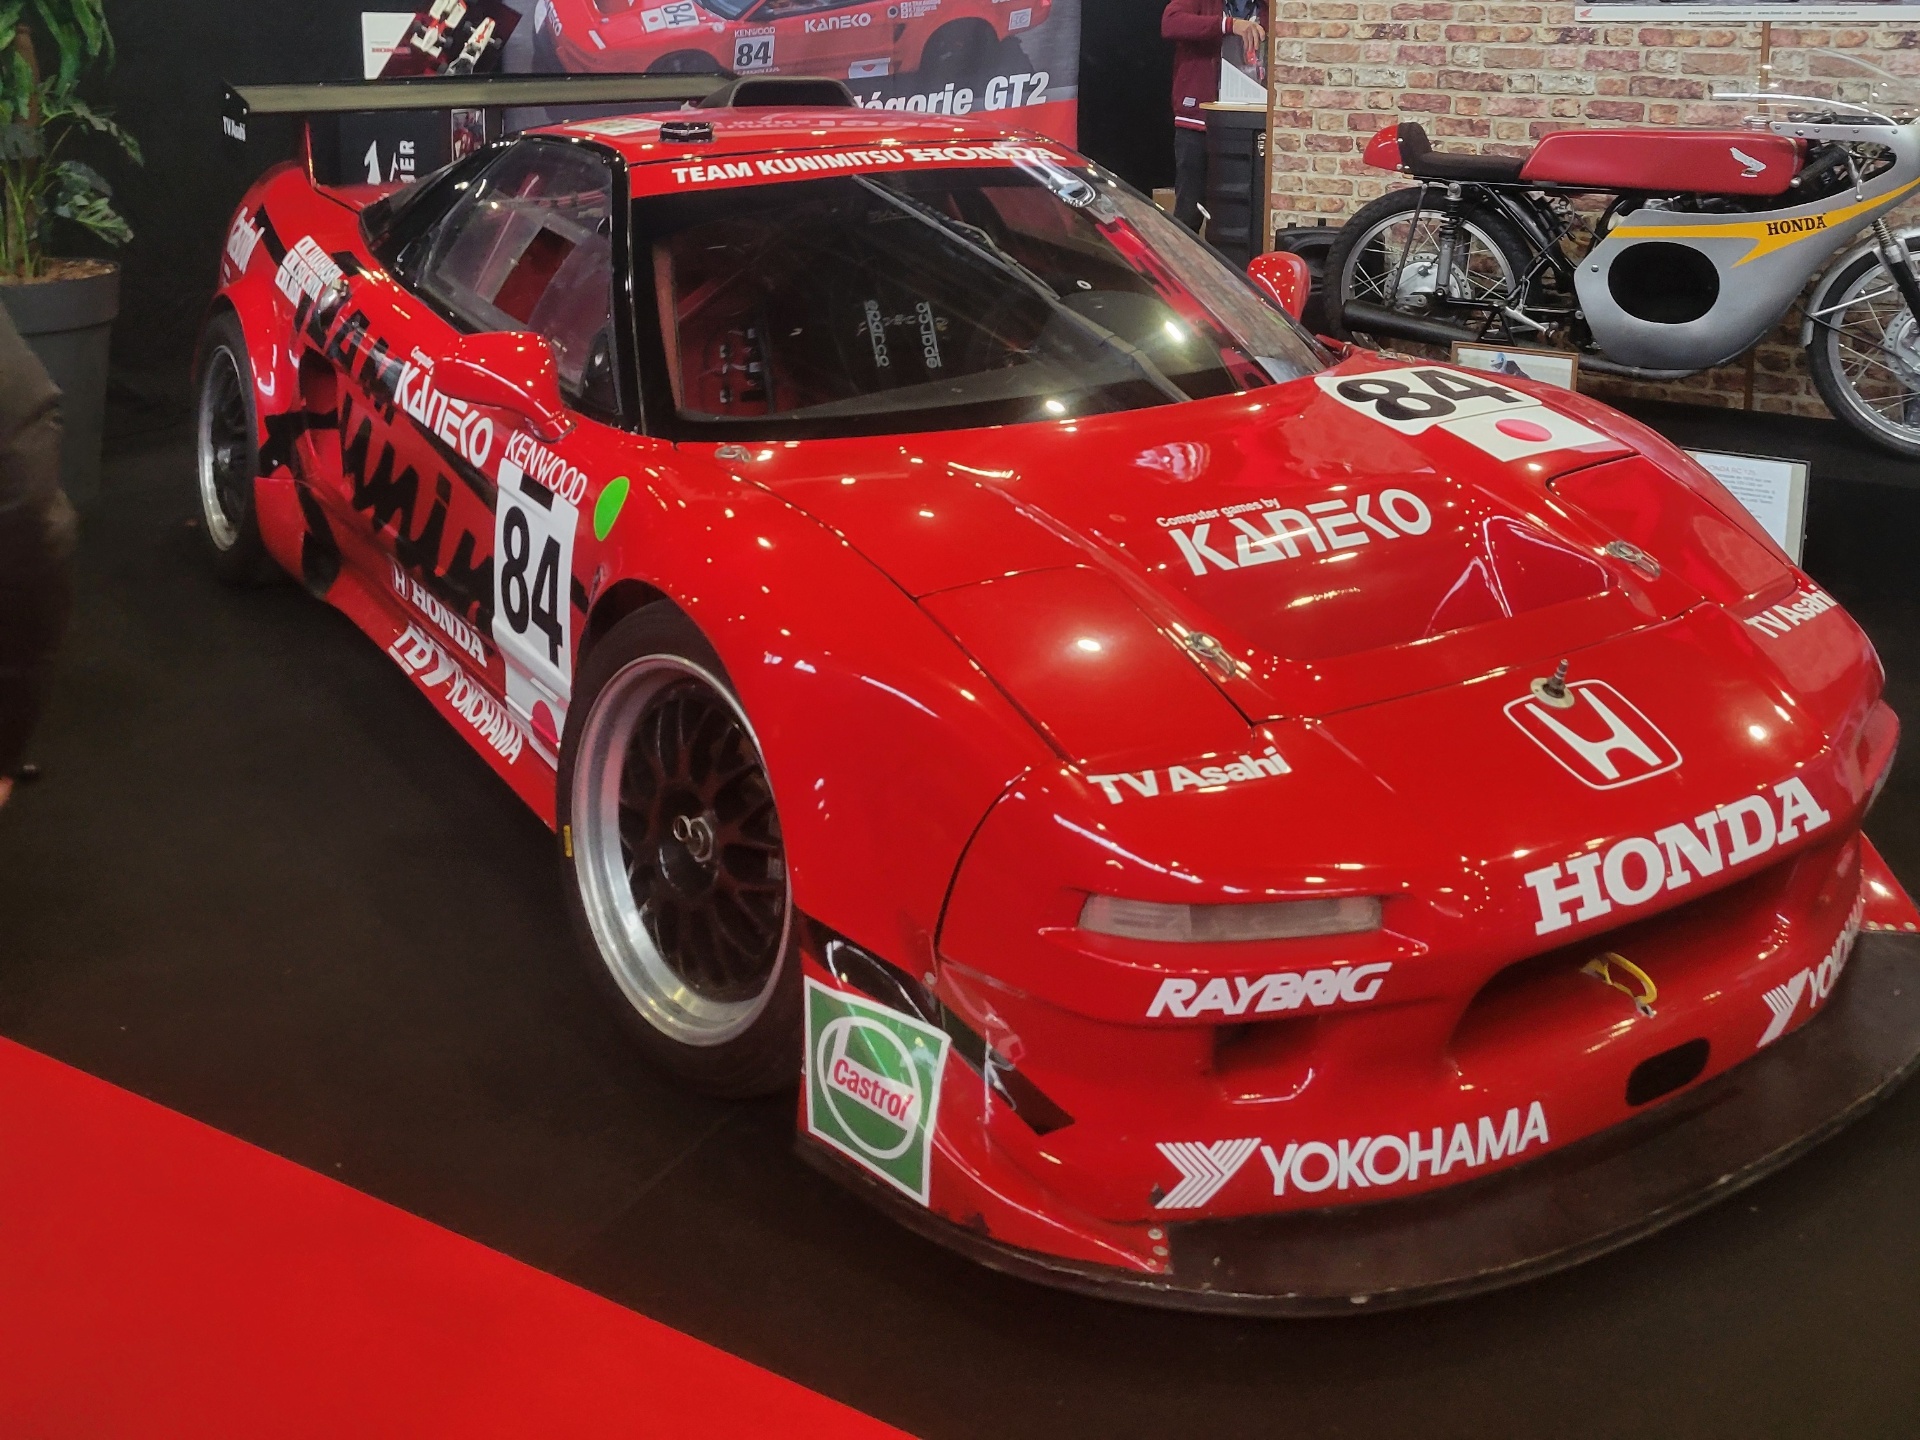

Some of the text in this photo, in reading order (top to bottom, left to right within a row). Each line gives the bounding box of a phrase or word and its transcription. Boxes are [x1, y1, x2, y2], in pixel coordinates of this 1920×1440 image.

[664, 2, 697, 25] 84
[734, 27, 776, 37] KENWOOD
[804, 13, 871, 33] KANEKO
[736, 41, 771, 66] 84
[984, 72, 1050, 111] GT2
[671, 147, 1067, 184] TEAM KUNIMITSU HONDA
[1766, 213, 1828, 237] HONDA
[915, 301, 942, 368] sparco
[393, 361, 494, 468] KANEKO
[1336, 368, 1525, 421] 84
[504, 430, 589, 506] KENWOOD
[1156, 497, 1281, 527] Computer games by
[1168, 488, 1432, 577] KANEKO
[501, 505, 563, 670] 84
[1743, 584, 1838, 639] TV Asahi
[410, 578, 488, 668] HONDA
[445, 658, 523, 765] YOKOHAMA
[1087, 746, 1293, 804] TV Asahi
[1523, 776, 1831, 936] HONDA
[1146, 961, 1392, 1018] RAYBRIG
[833, 1057, 915, 1122] Castrol
[1259, 1101, 1550, 1197] YOKOHAMA
